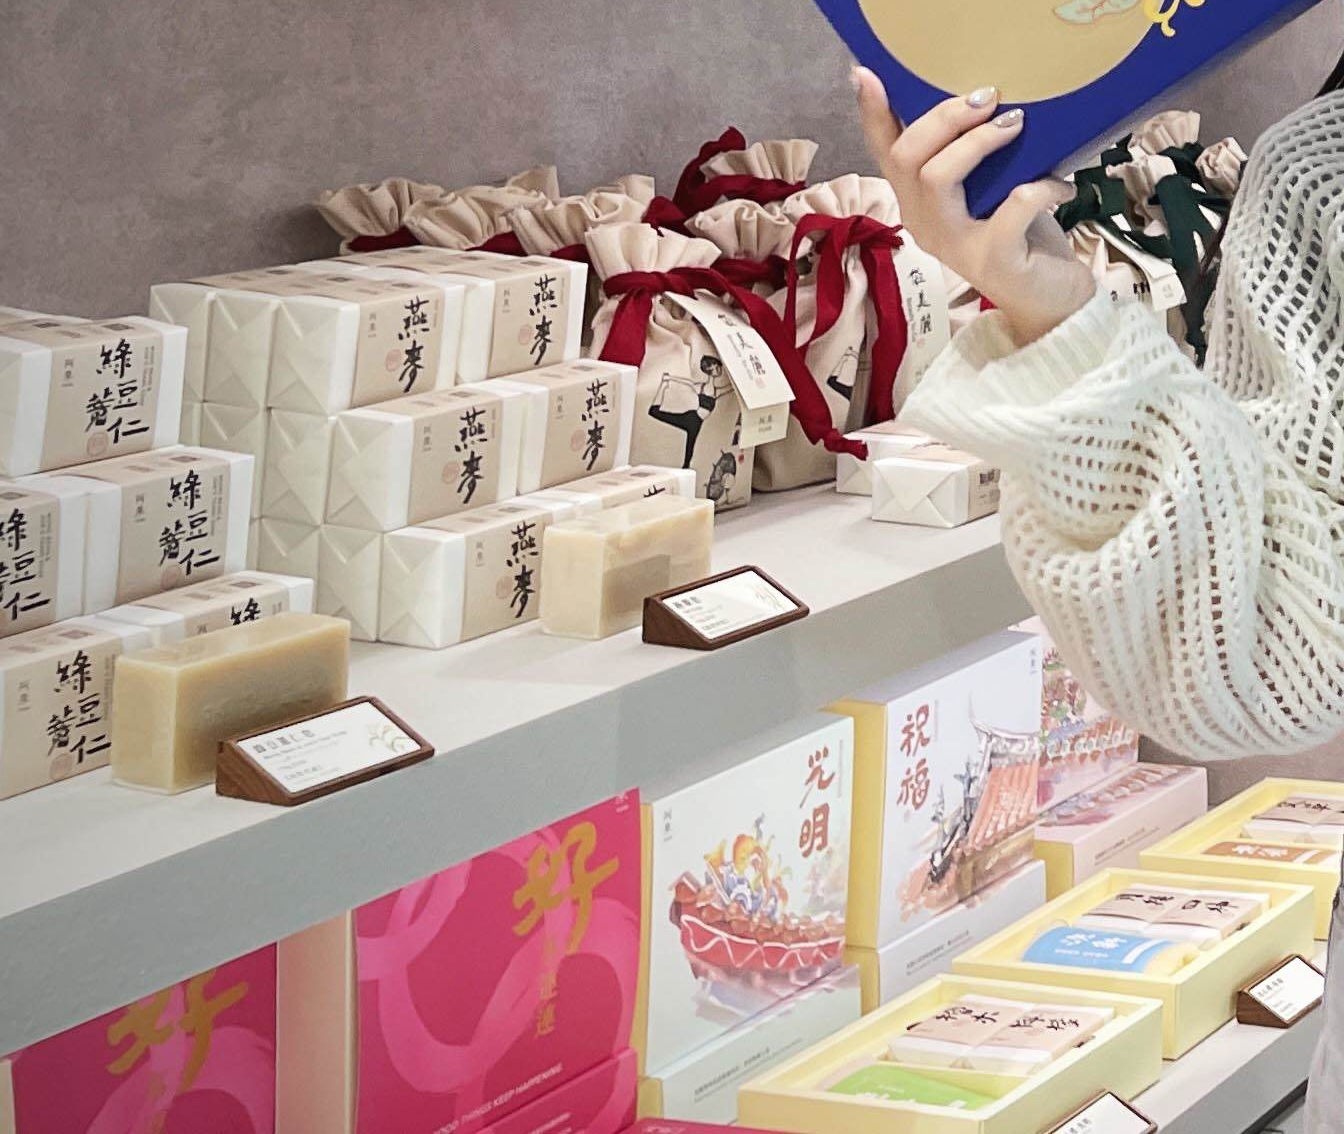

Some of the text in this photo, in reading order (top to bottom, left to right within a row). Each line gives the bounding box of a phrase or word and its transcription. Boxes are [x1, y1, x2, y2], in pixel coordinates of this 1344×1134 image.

[398, 294, 431, 394] 燕麥
[529, 273, 559, 366] 燕麥
[85, 337, 150, 444] 綠豆薏仁
[581, 377, 610, 472] 燕麥
[454, 405, 488, 505] 燕麥
[159, 468, 221, 577] 綠豆薏仁
[506, 519, 539, 619] 燕麥
[47, 649, 112, 765] 綠豆薏仁
[896, 703, 932, 811] 祝福
[798, 744, 837, 859] 光明
